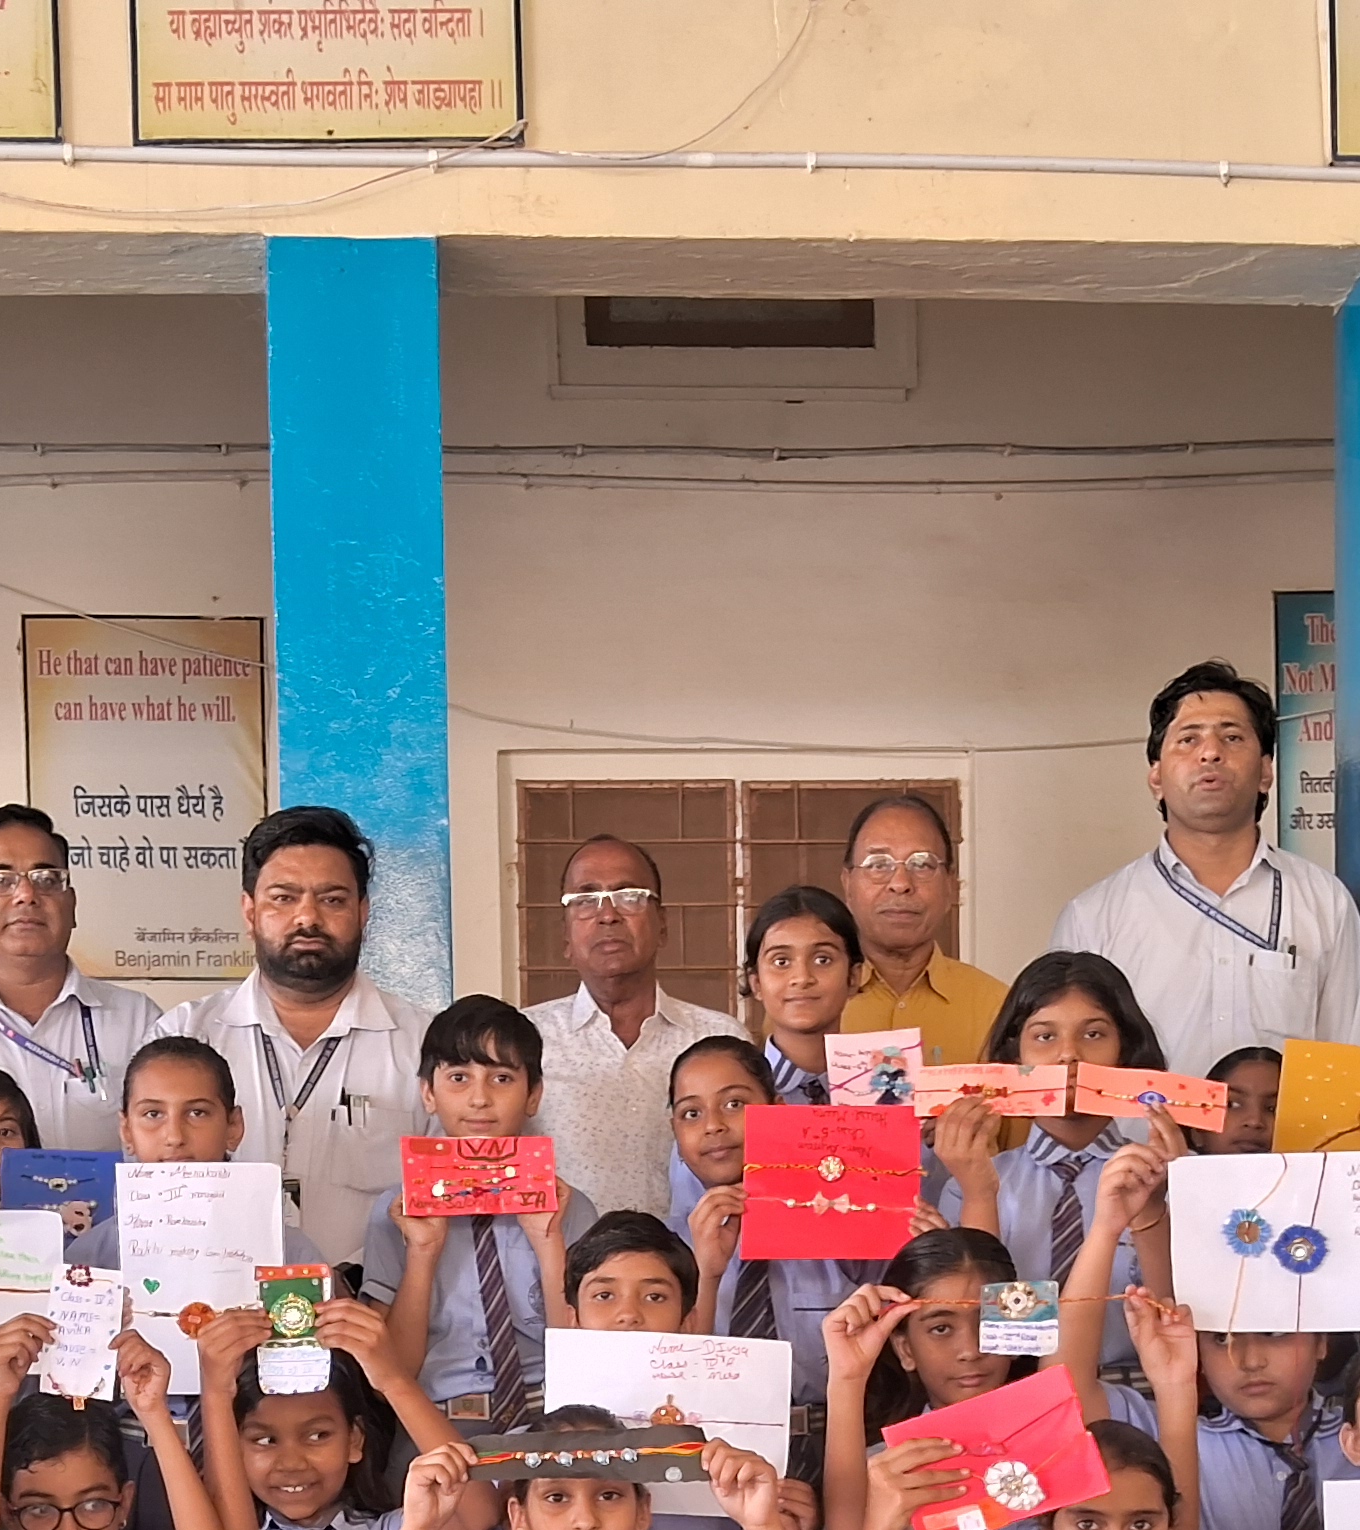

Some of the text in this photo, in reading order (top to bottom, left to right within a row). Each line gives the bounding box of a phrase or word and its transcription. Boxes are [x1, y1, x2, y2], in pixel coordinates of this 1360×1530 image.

[167, 9, 186, 38] या
[390, 9, 417, 45] सदा
[153, 82, 173, 113] सा
[207, 82, 237, 125] पातु
[239, 68, 297, 113] सरस्वती
[301, 68, 353, 112] भगवती
[383, 66, 409, 114] शेष
[38, 650, 251, 684] He that can have patience
[1282, 663, 1314, 695] Not
[55, 695, 236, 722] can have what he will.
[73, 784, 224, 822] जिसके पास धैर्य है
[1290, 808, 1313, 831] और
[69, 835, 237, 873] जो चाहे वो पा सकता
[114, 950, 191, 971] Benjamin
